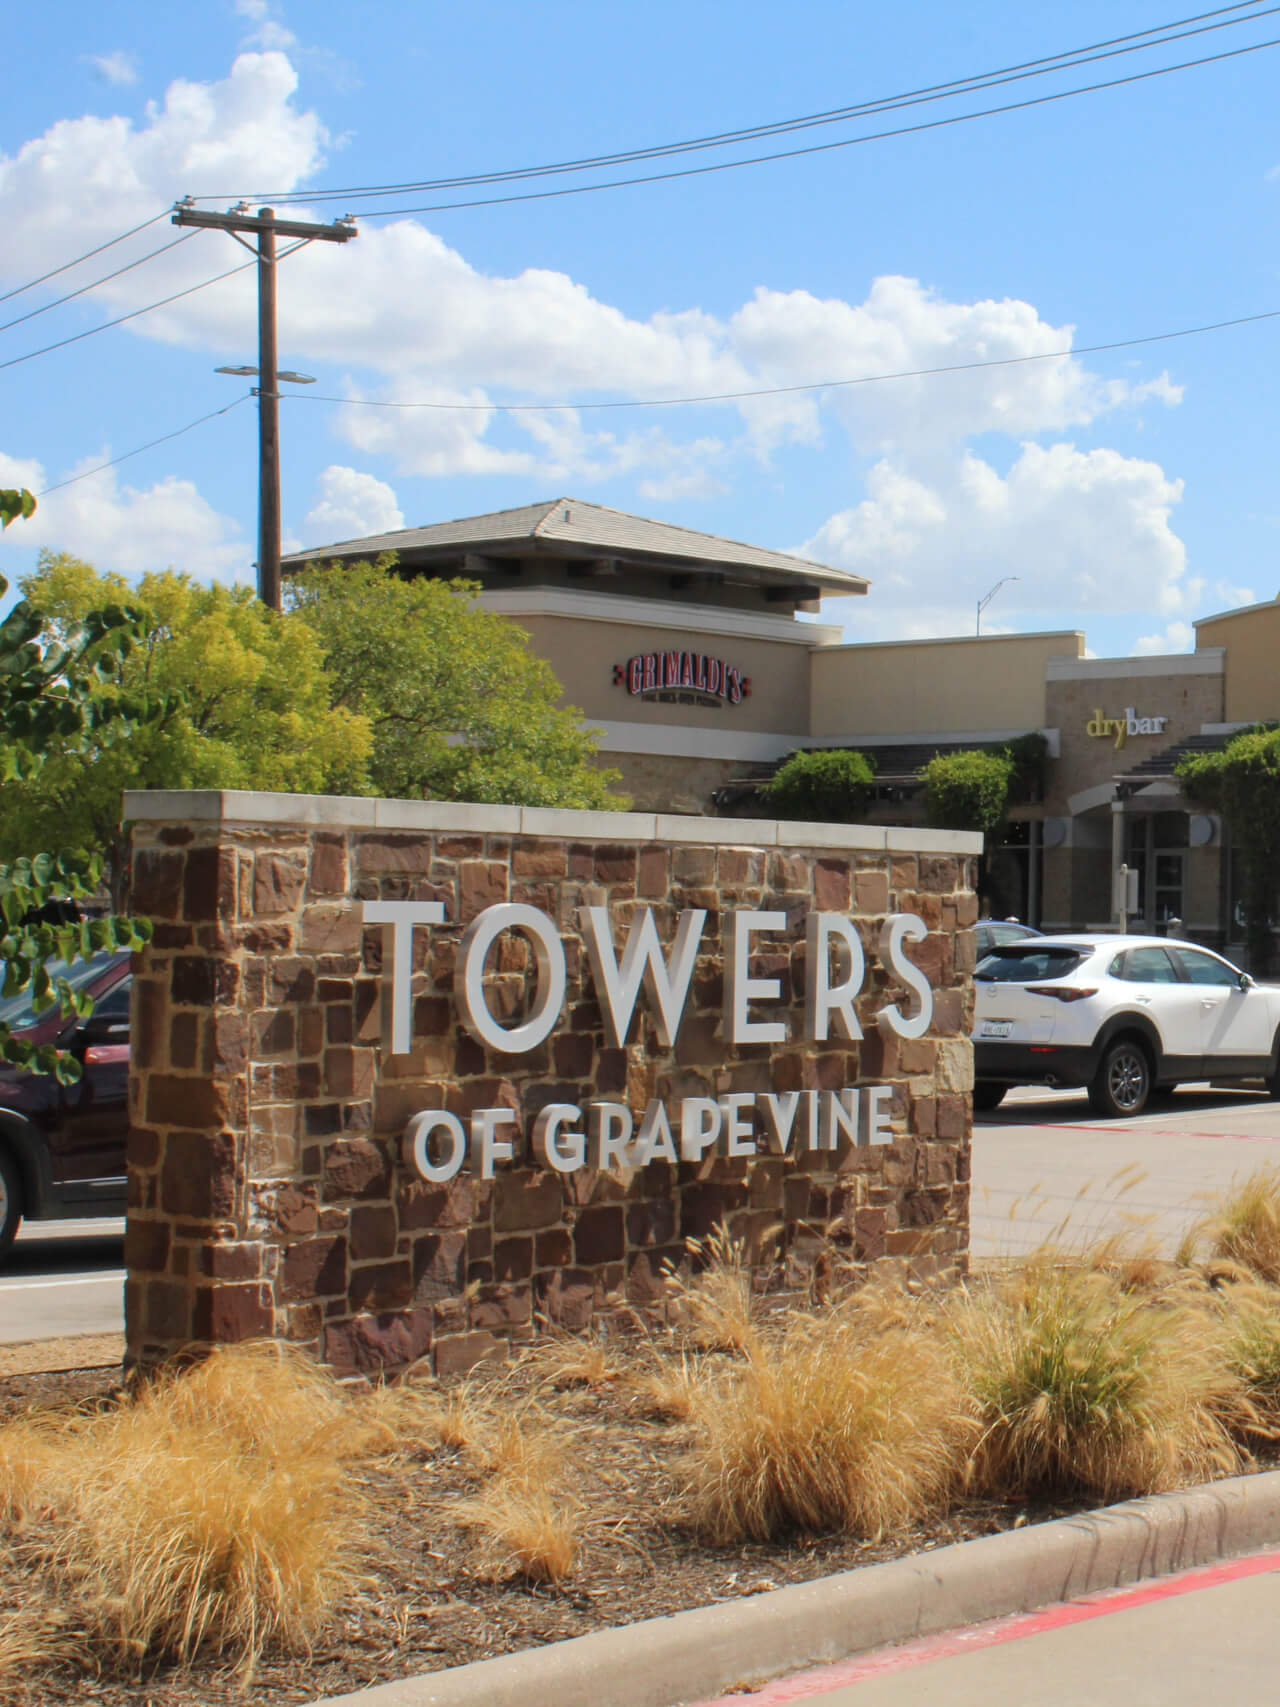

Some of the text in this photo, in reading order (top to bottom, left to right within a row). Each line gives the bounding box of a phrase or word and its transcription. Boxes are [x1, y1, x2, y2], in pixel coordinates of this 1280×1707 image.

[628, 651, 742, 704] GRIMALDI'S
[1087, 706, 1168, 750] drybar
[361, 900, 935, 1055] TOWERS
[406, 1085, 894, 1183] OF GRAPEVINE
